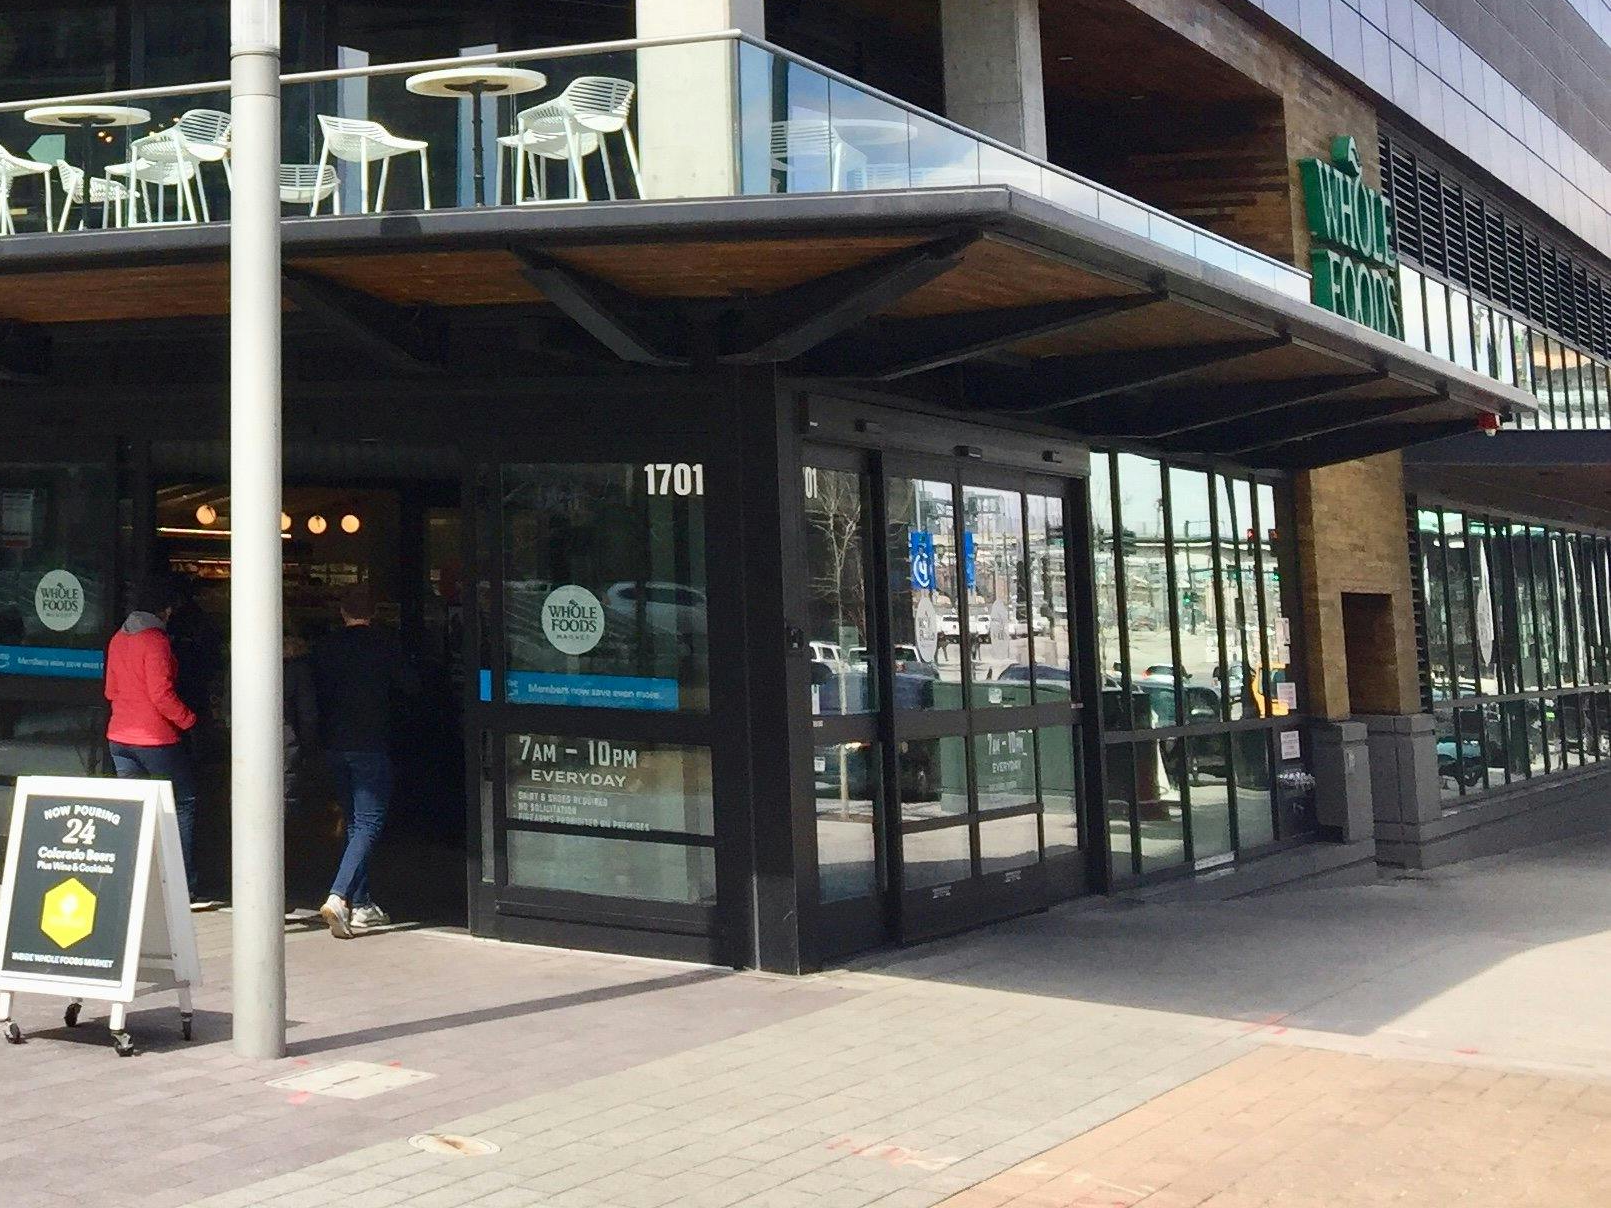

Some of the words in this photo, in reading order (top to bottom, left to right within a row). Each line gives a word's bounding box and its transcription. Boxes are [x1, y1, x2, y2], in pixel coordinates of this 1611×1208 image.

[1298, 135, 1397, 270] WHOLE
[644, 463, 704, 496] 1701
[40, 582, 79, 600] WHOLE
[42, 599, 79, 613] FOODS
[548, 599, 598, 620] WHOLE
[551, 617, 598, 633] FOODS
[531, 769, 626, 788] EVERYDAY
[44, 805, 71, 821] NOW
[73, 804, 121, 826] POURING
[62, 818, 96, 845] 24
[37, 846, 86, 861] Colorado
[86, 848, 116, 863] Beers
[35, 953, 59, 964] WHOLE
[59, 955, 83, 966] FOODS
[84, 958, 114, 969] MARKET
